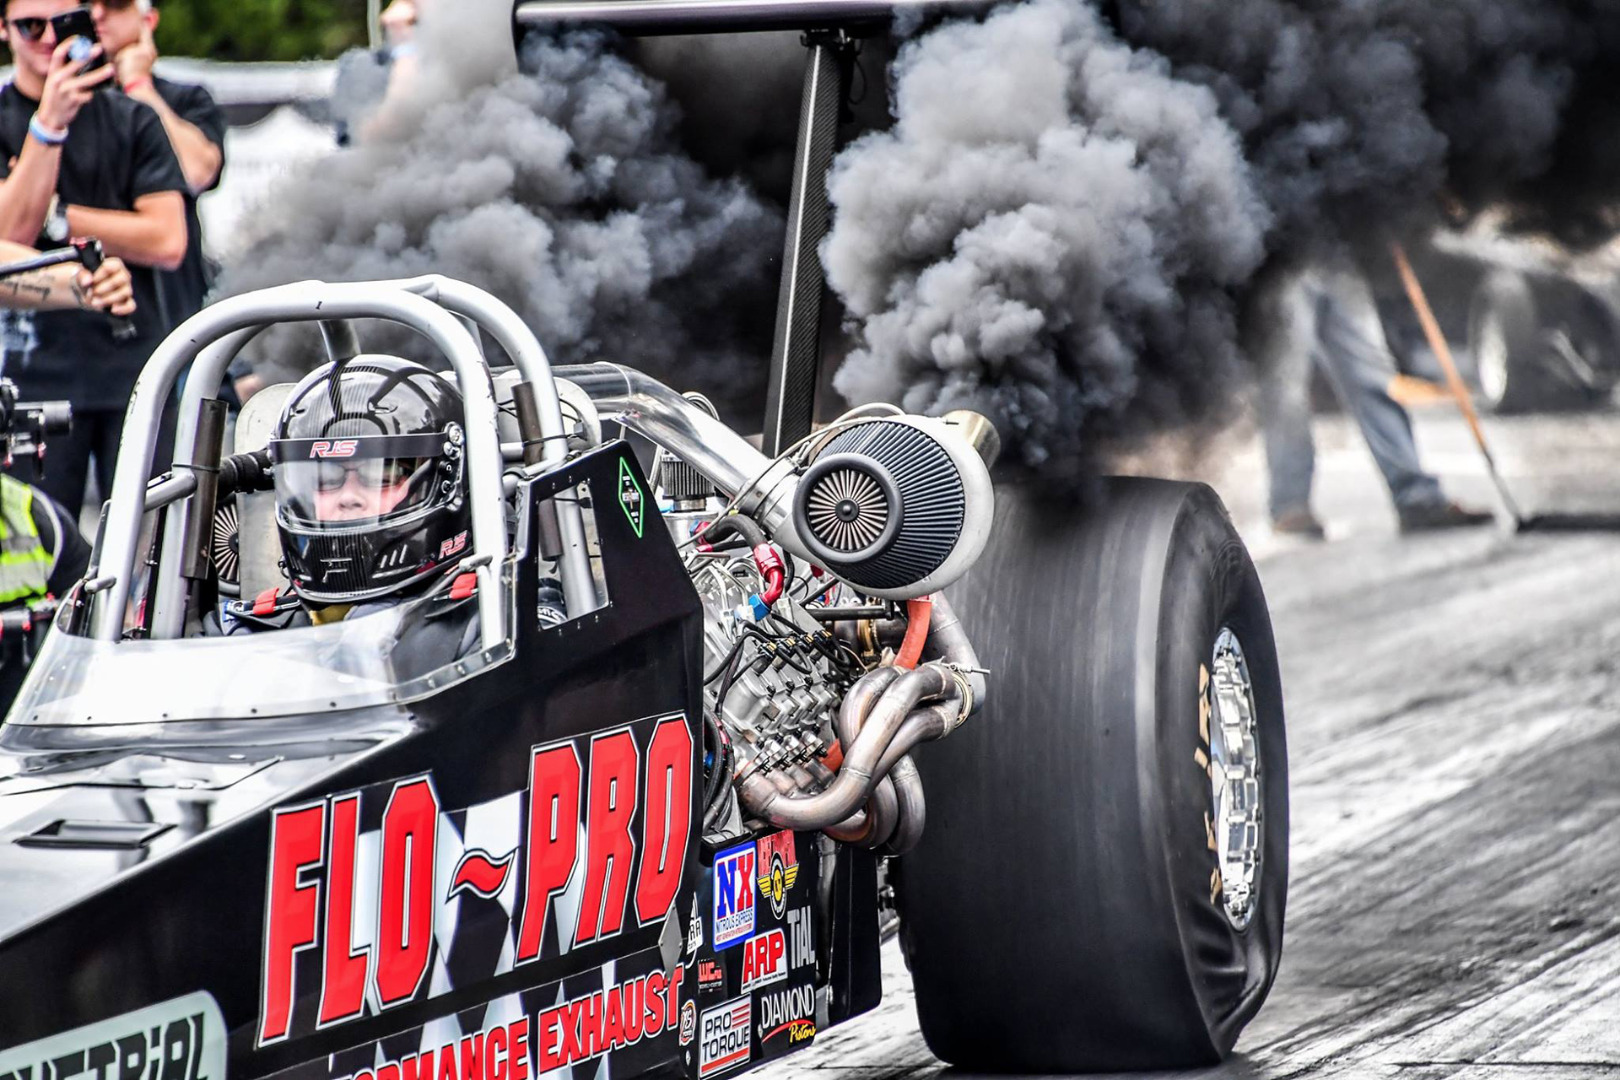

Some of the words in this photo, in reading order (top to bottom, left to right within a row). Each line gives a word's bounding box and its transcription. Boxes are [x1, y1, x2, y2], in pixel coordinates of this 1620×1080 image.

[716, 851, 754, 920] NX
[742, 931, 785, 984] ARP
[537, 962, 684, 1077] EXHAUST
[705, 1011, 732, 1040] PRO
[760, 983, 815, 1029] DIAMOND
[702, 1025, 750, 1062] TORQUE
